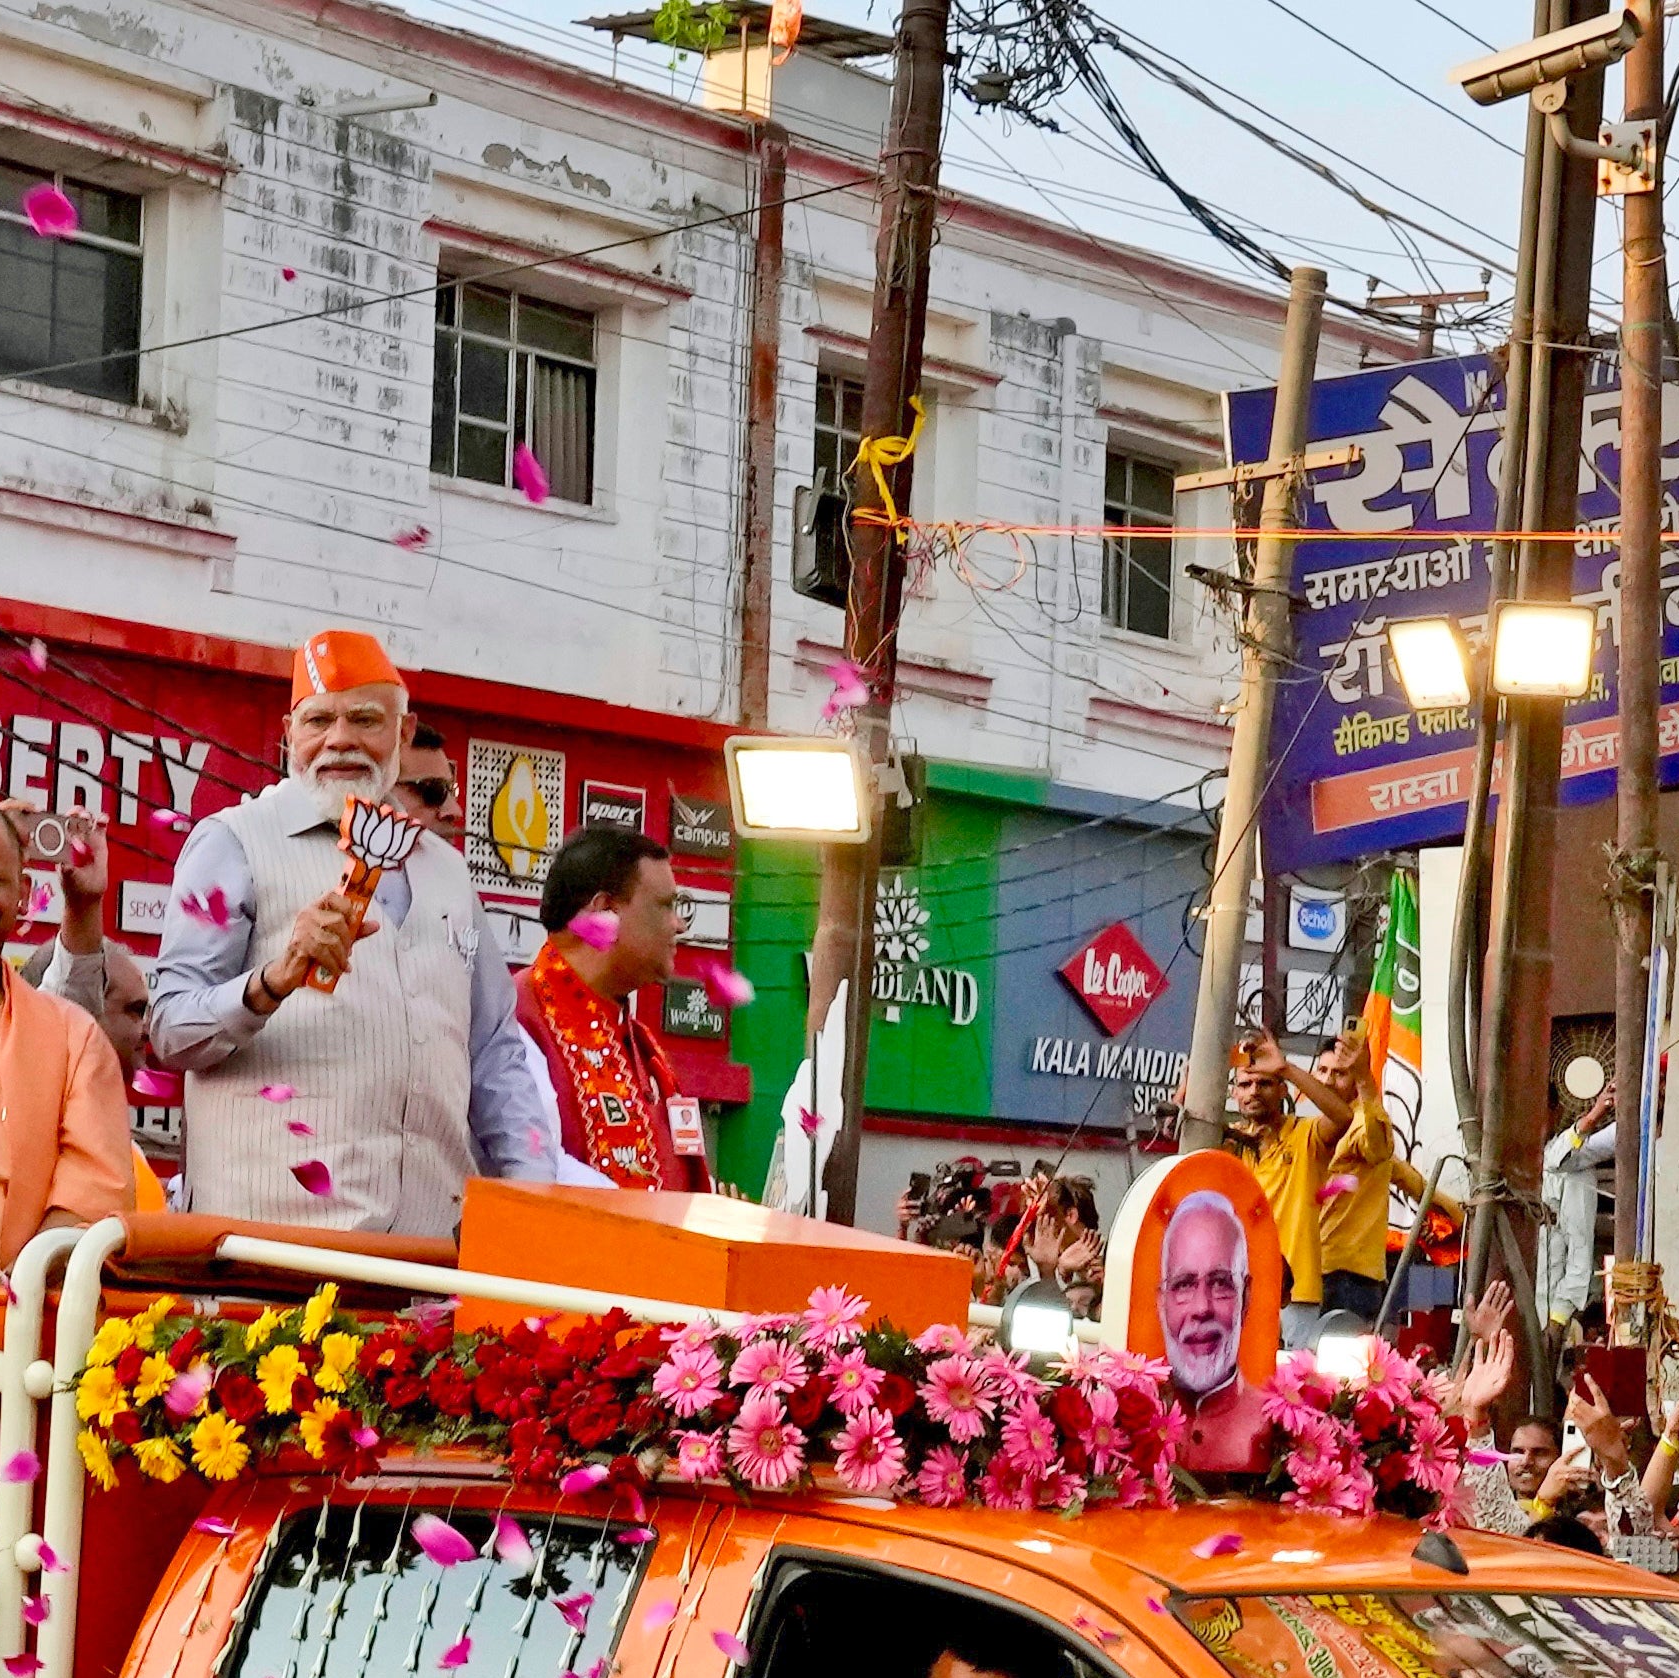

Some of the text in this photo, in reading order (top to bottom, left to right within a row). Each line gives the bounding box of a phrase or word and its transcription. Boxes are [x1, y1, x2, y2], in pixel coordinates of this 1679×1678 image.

[1302, 540, 1473, 610] समस्याओं
[1367, 765, 1460, 813] रास्ता
[586, 799, 641, 824] sparx
[673, 822, 731, 848] campus
[670, 1008, 723, 1033] WOODLAND
[1030, 1036, 1188, 1088] KALA MANDIR
